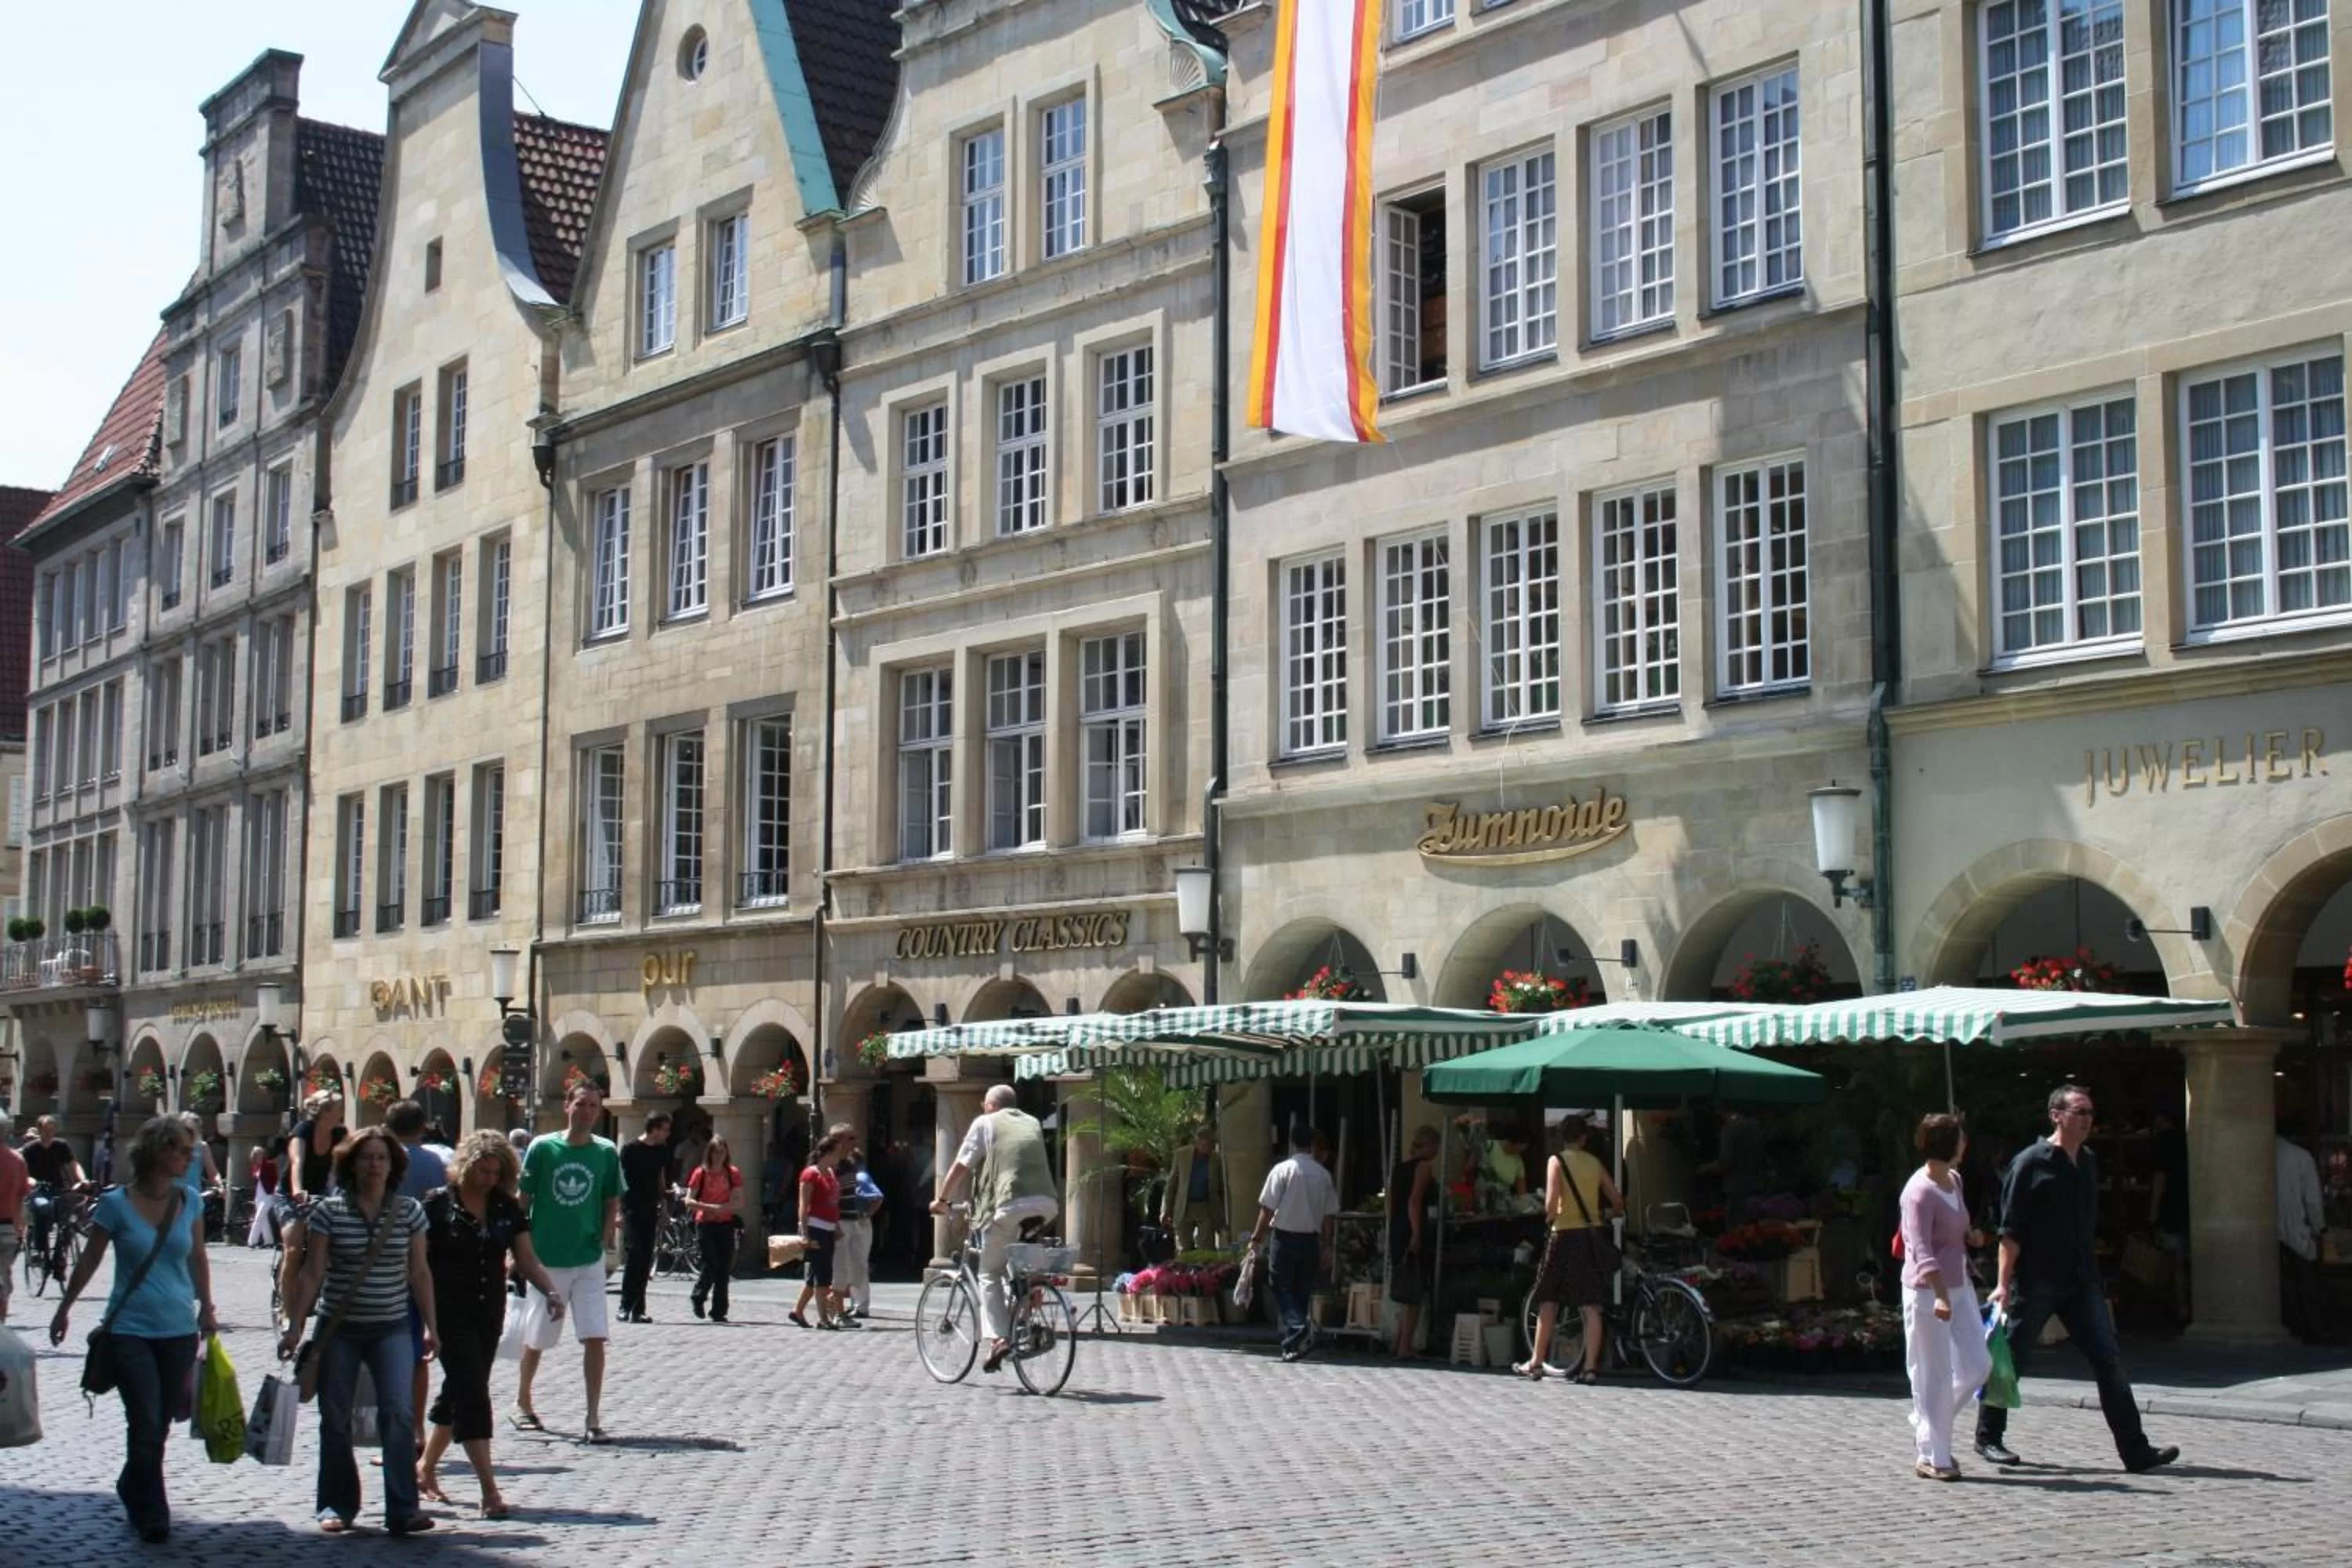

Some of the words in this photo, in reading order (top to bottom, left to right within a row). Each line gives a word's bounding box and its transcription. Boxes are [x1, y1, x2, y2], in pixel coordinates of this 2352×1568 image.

[2083, 726, 2330, 809] JUWELIER
[895, 920, 1004, 960] COUNTRY
[1008, 910, 1131, 953] CLASSICS
[641, 949, 695, 998] pur
